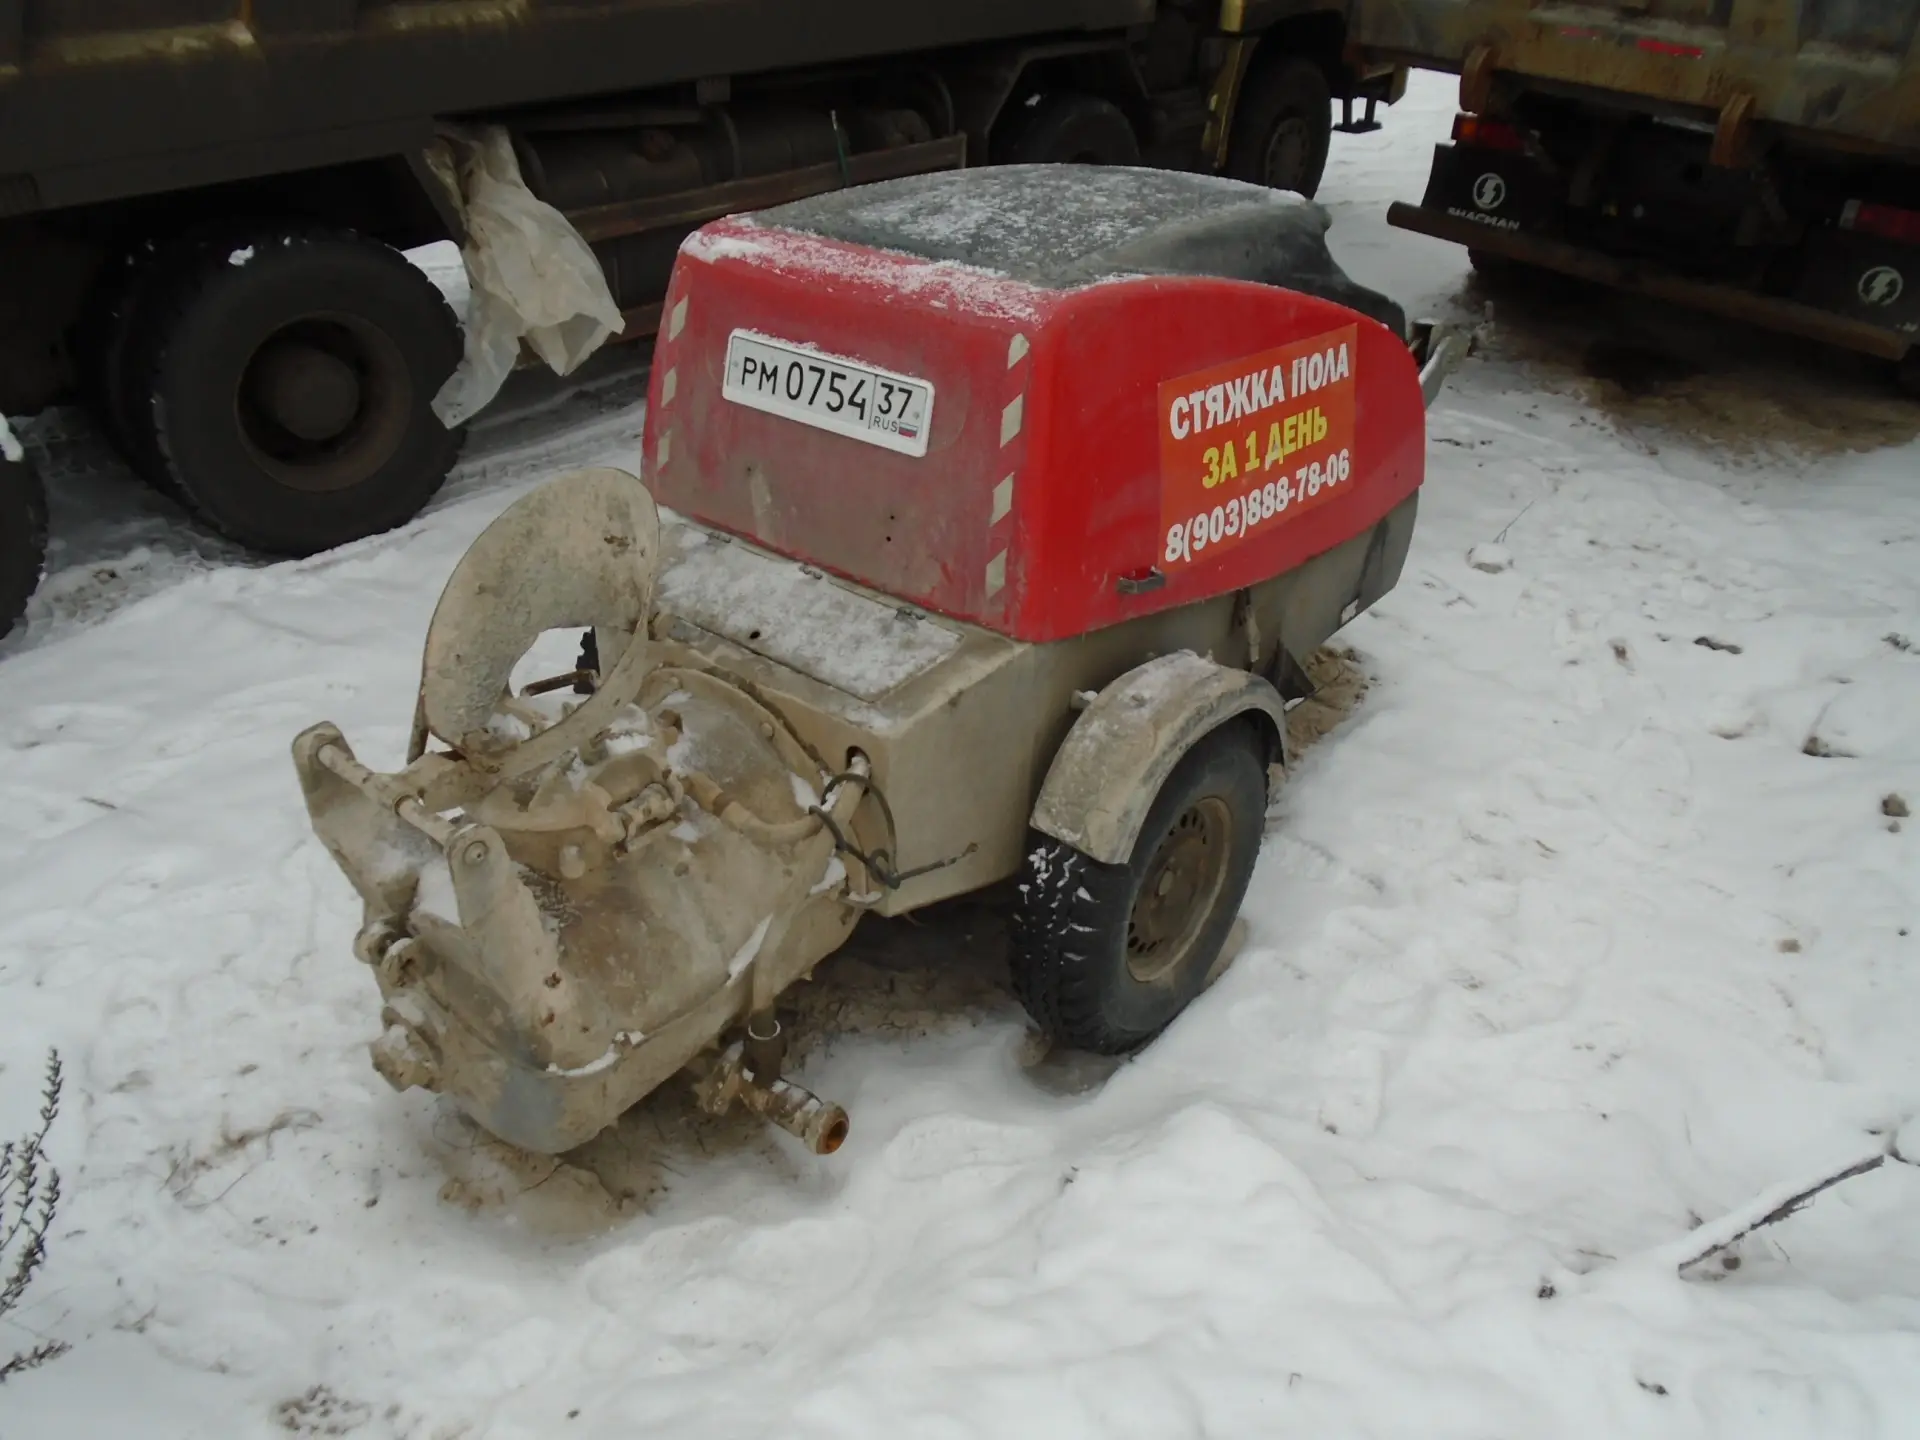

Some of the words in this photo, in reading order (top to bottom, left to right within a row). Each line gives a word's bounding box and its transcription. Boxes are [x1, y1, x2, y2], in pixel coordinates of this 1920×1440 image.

[873, 415, 898, 433] RUS
[877, 382, 914, 419] 37
[1170, 365, 1285, 440] СТЯЖКА
[1291, 343, 1349, 398] ПОЛА
[1202, 440, 1238, 489] ЗА
[1245, 430, 1260, 472] 1
[1264, 406, 1328, 471] ДЕНЬ
[1165, 448, 1350, 562] 8(903)888-78-06
